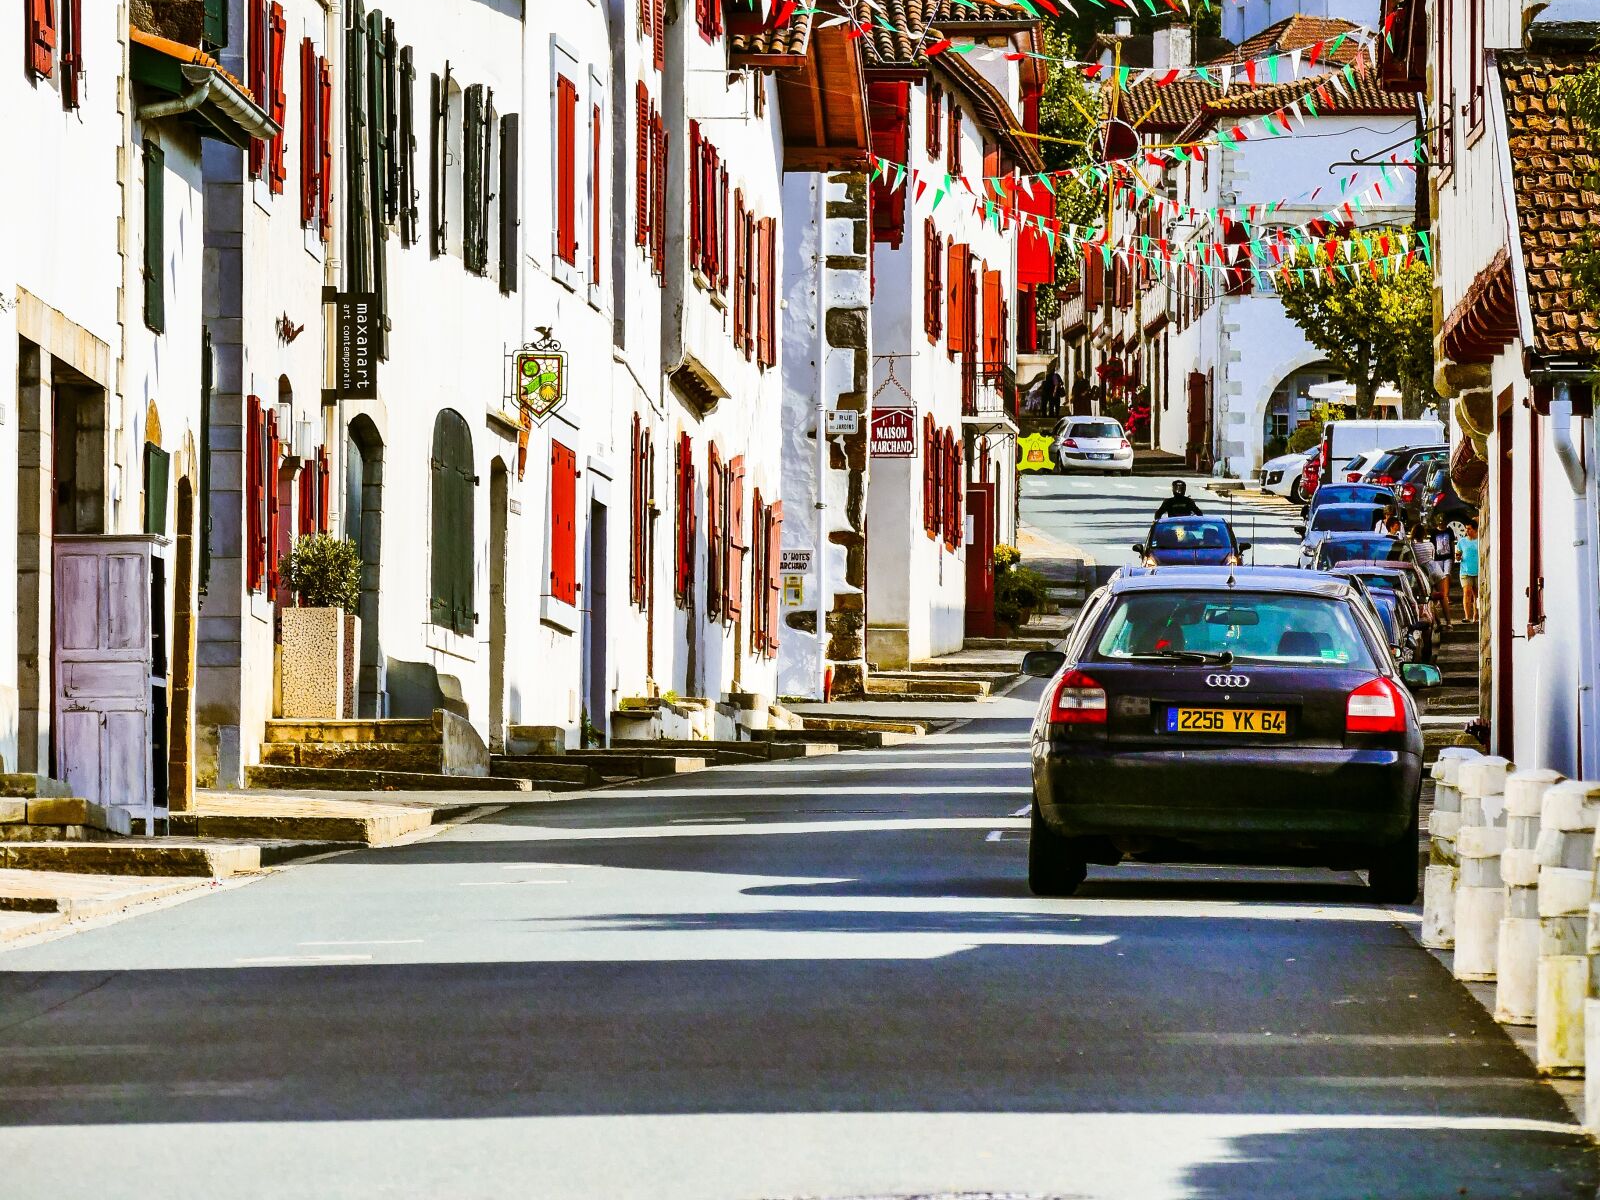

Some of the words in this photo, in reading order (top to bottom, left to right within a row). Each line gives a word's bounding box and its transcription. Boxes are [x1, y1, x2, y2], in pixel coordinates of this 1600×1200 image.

[343, 304, 351, 320] art
[356, 303, 370, 389] maxanart
[341, 325, 351, 389] contemporain
[876, 426, 908, 439] MAISON
[870, 440, 913, 453] MARCHAND
[779, 561, 808, 570] ARCHAND
[1181, 710, 1224, 729] 2256
[1232, 711, 1255, 730] YK
[1261, 712, 1283, 731] 64
